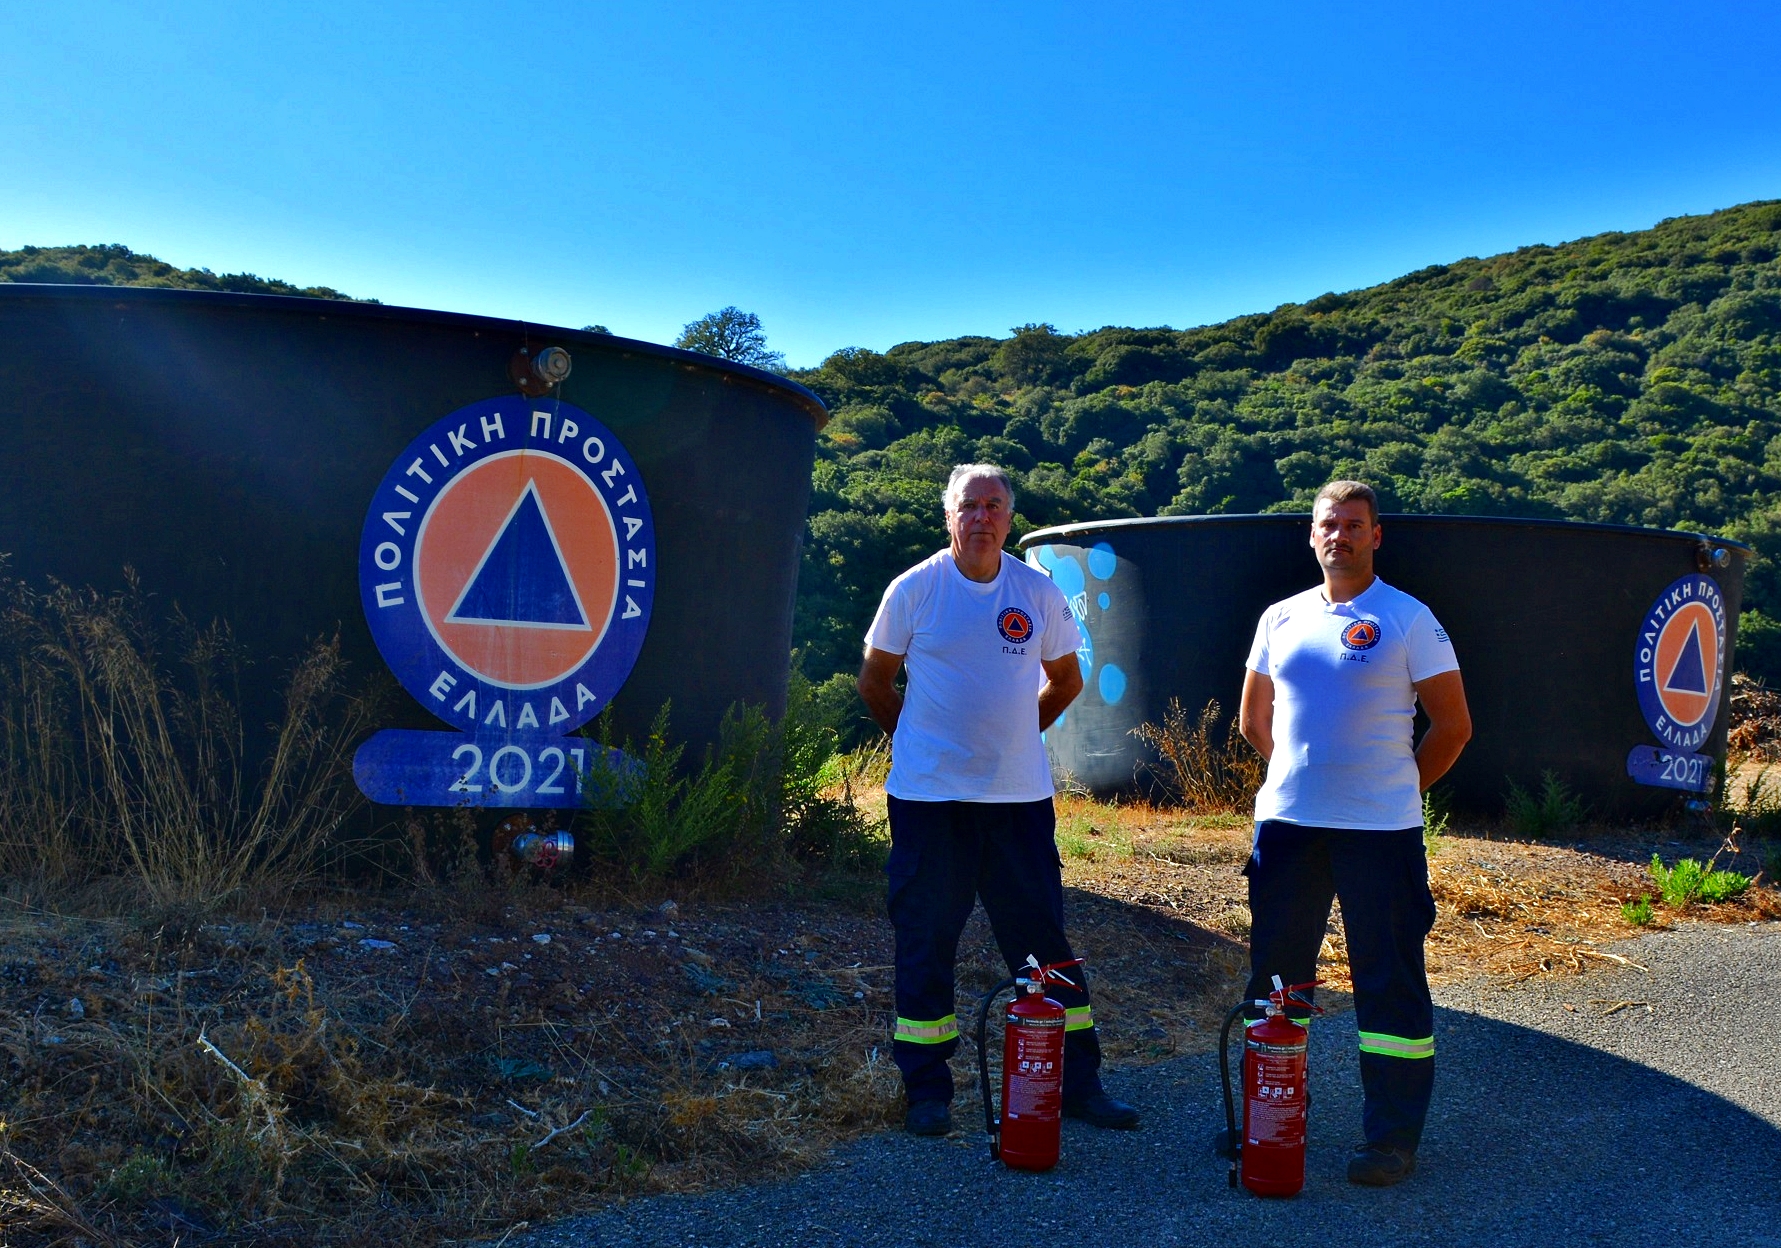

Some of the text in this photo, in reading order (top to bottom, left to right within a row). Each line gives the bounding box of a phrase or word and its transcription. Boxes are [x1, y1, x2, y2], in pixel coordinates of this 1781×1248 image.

[374, 411, 647, 620] ΠΟΛΙΤΙΚΗ ΠΡΟΣΤΑΣΙΑ
[1339, 652, 1369, 663] Π.Δ.Ε.
[1640, 582, 1691, 682] ΠΟΛΙΤΙΚΗ
[428, 670, 596, 730] ΕΛΛΑΔΑ
[1656, 715, 1708, 747] ΕΛΛΑΔΑ
[448, 743, 585, 794] 2021
[1660, 754, 1703, 785] 2021
